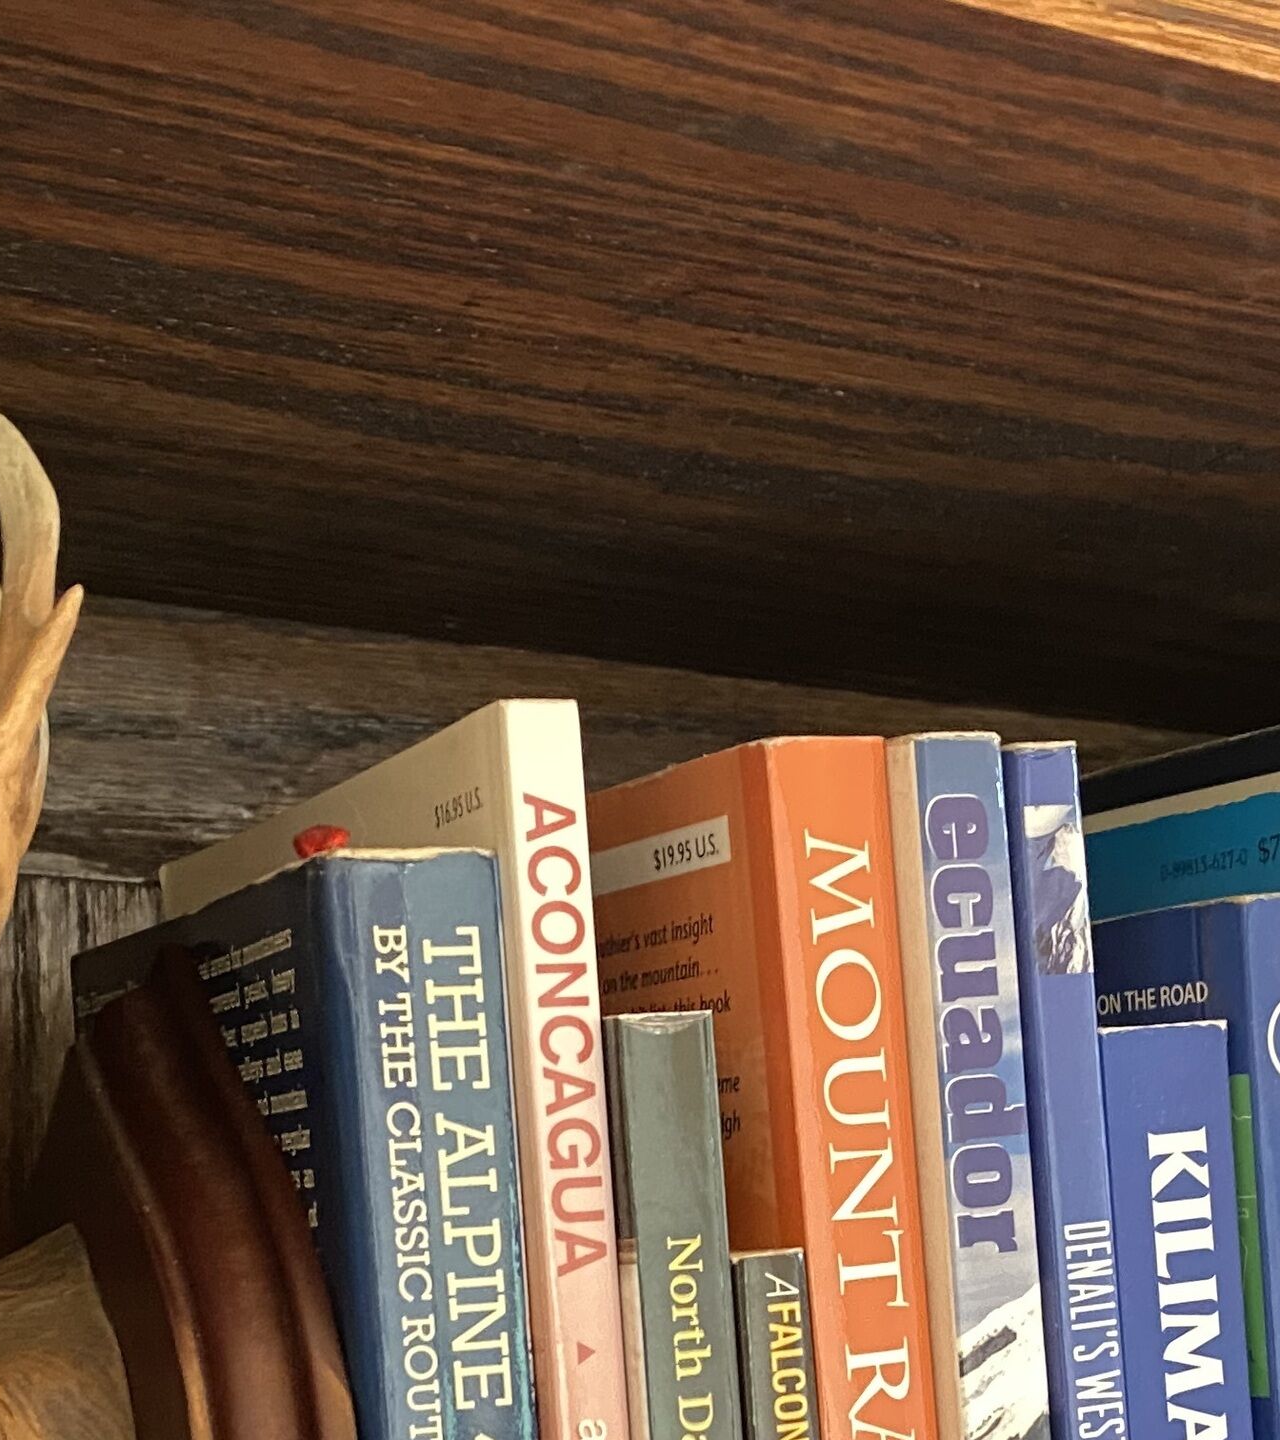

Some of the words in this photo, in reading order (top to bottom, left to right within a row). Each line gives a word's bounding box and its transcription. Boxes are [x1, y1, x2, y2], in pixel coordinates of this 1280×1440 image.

[434, 791, 466, 830] $16.95
[652, 840, 694, 873] $19.95
[694, 832, 720, 860] U.S.
[371, 924, 408, 977] BY
[643, 925, 668, 949] vast
[671, 912, 714, 946] insight
[1096, 993, 1122, 1016] ON
[1124, 988, 1157, 1013] THE
[1160, 980, 1209, 1008] ROAD
[378, 993, 419, 1088] THE
[422, 924, 491, 1091] THE
[521, 791, 609, 1277] ACONCAGUA
[803, 828, 910, 1308] MOUNT
[925, 793, 1027, 1254] ecuador
[385, 1101, 433, 1303] CLASSIC
[433, 1111, 514, 1411] ALPINE
[665, 1233, 713, 1382] North
[1063, 1219, 1119, 1363] DENALI'S
